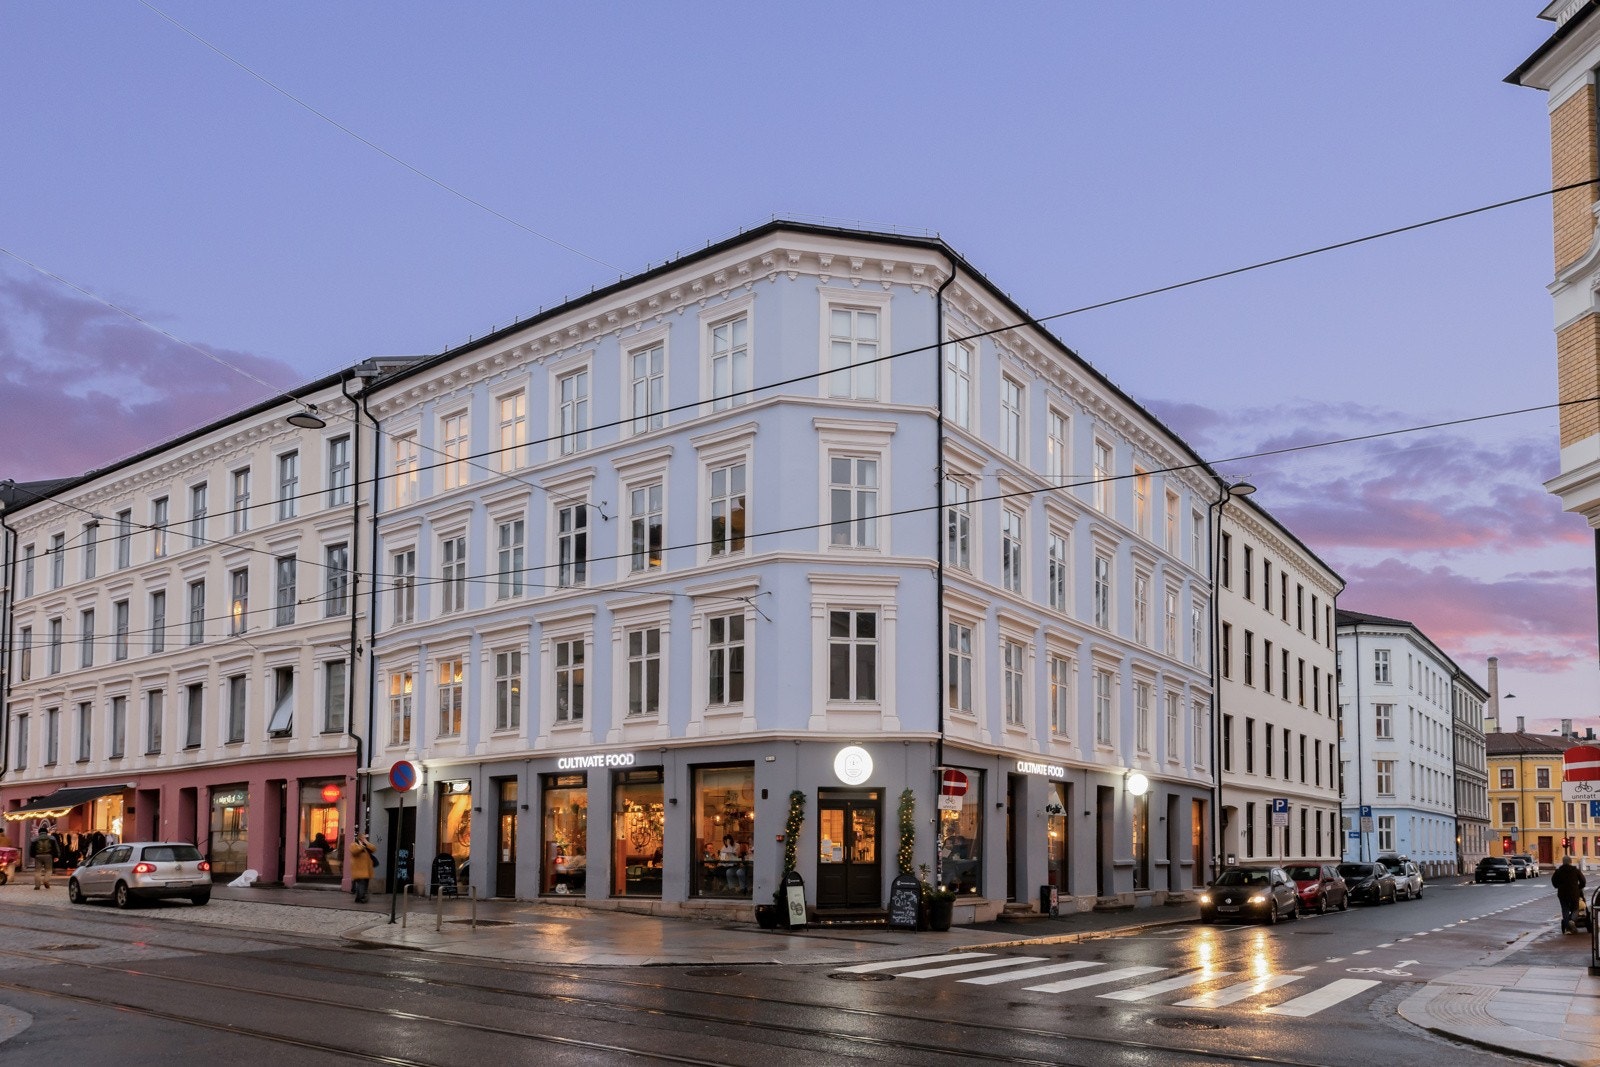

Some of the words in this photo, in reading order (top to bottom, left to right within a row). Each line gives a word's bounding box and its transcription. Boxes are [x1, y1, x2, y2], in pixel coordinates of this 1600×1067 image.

[558, 755, 604, 769] CULTIVATE
[606, 753, 635, 766] FOOD
[1017, 761, 1048, 775] CULTIVATE
[1048, 765, 1064, 778] FOOD
[1276, 800, 1285, 811] P
[1362, 807, 1369, 816] P
